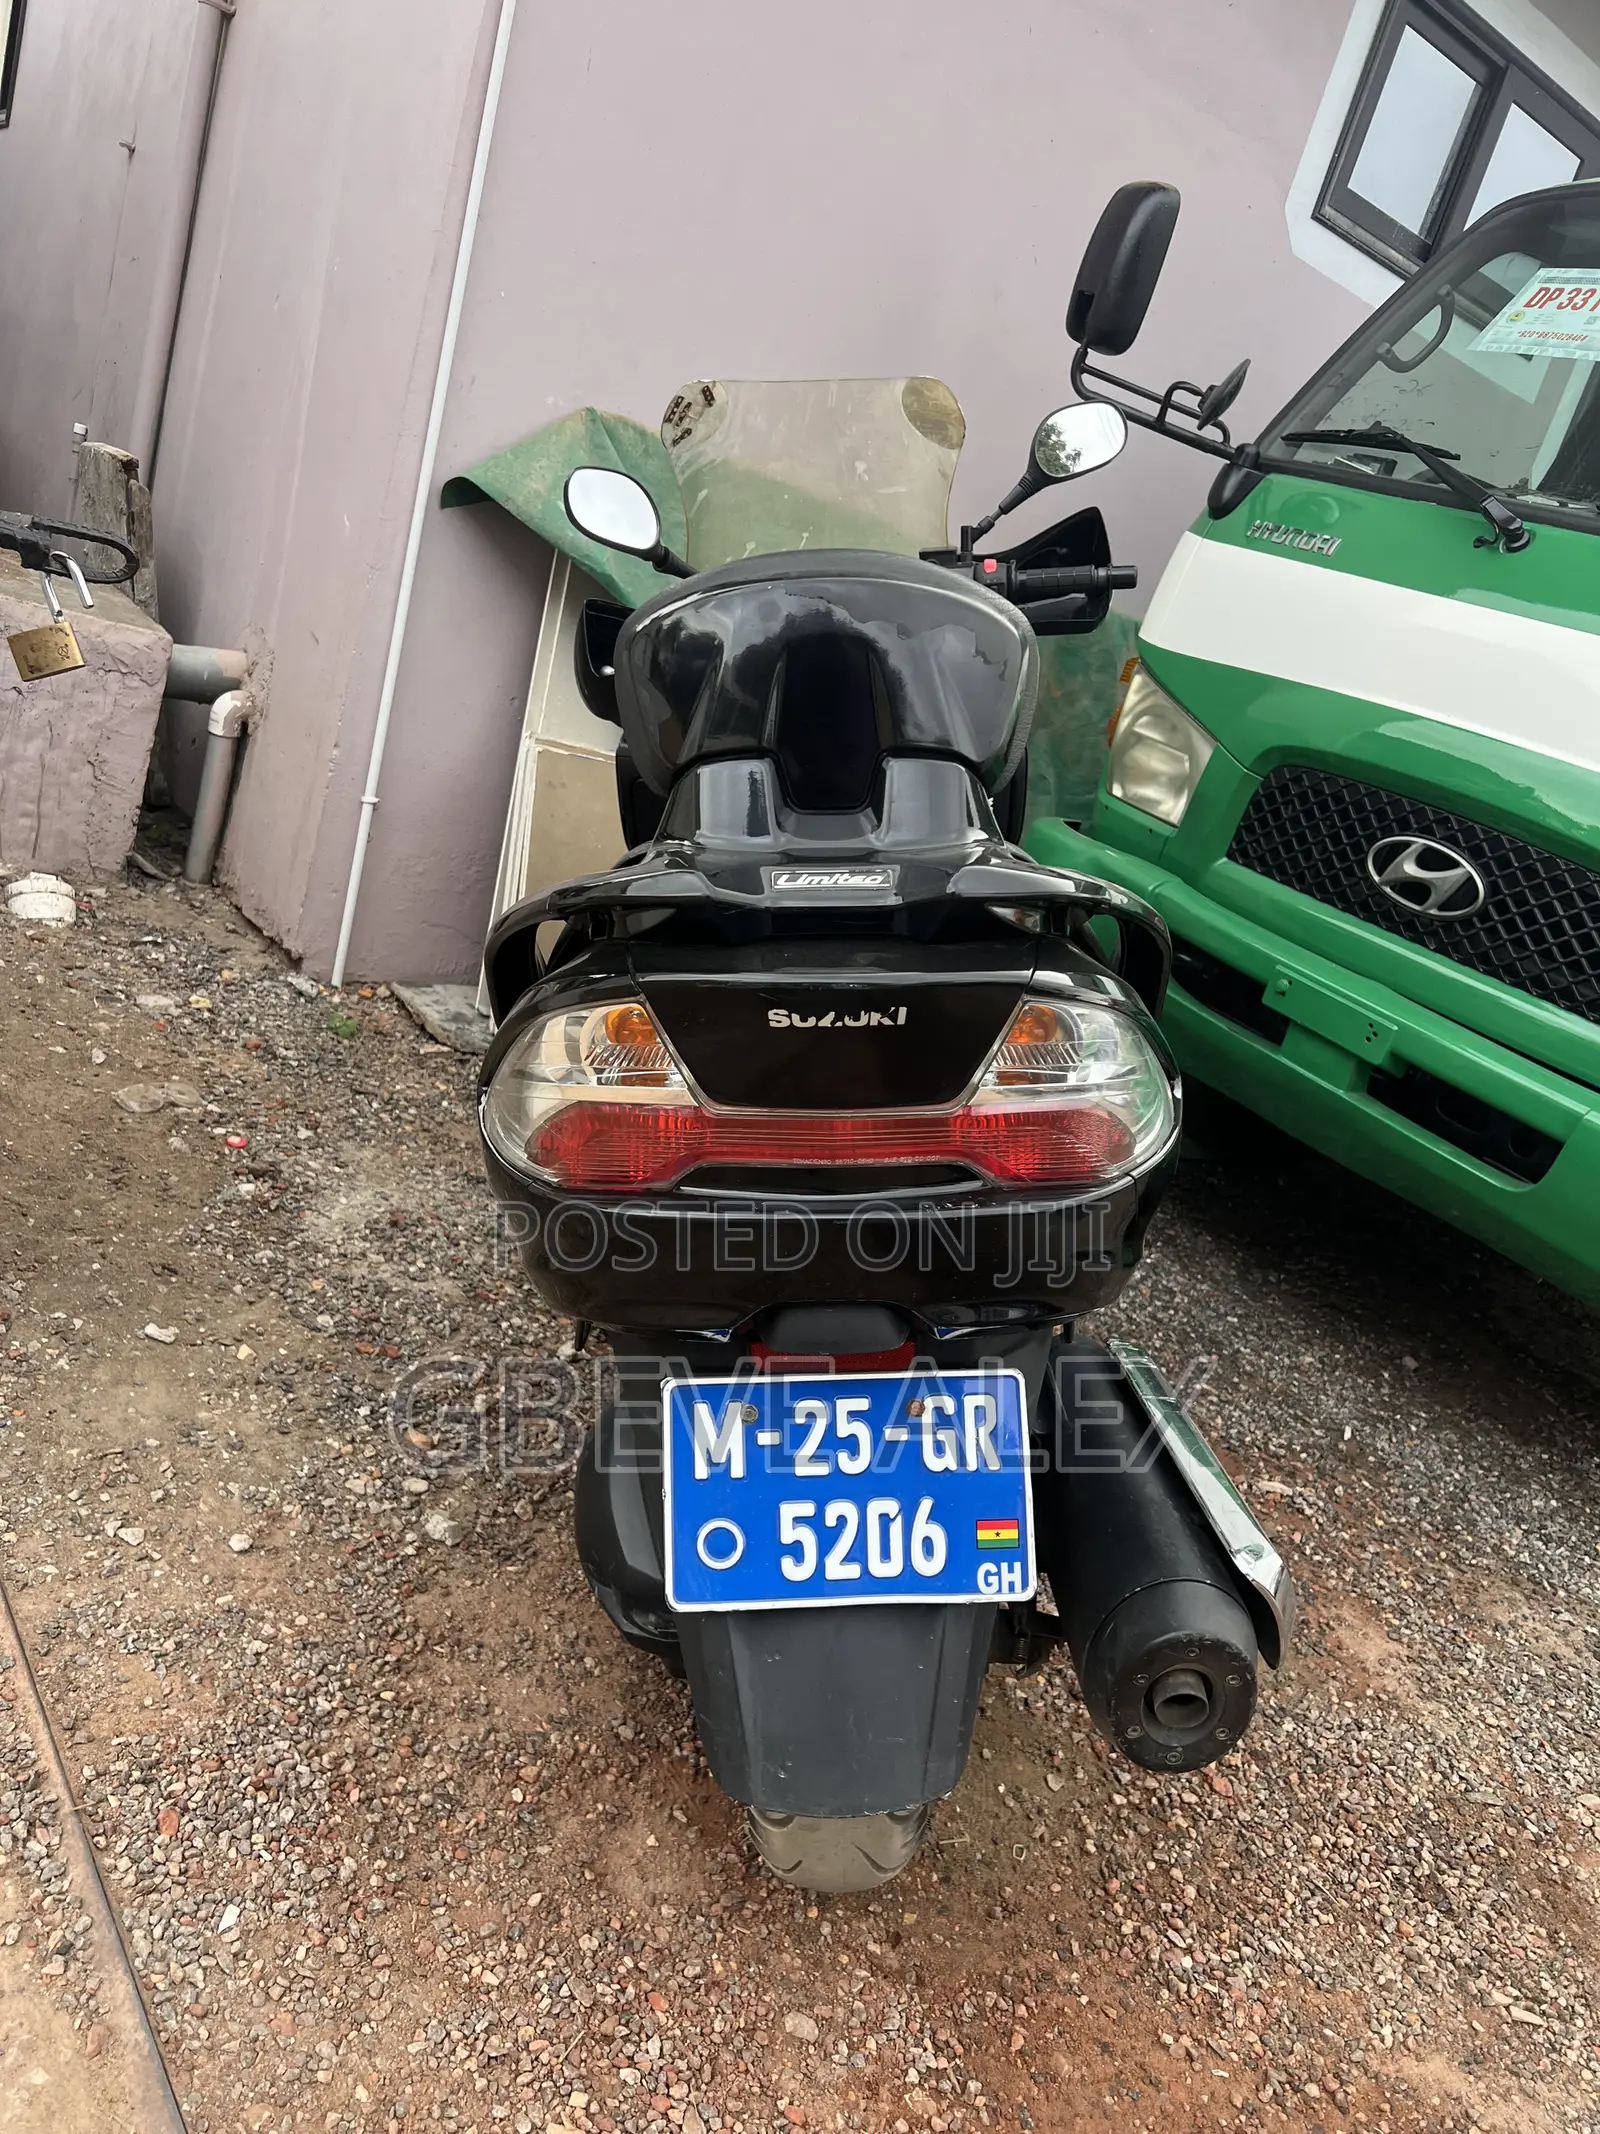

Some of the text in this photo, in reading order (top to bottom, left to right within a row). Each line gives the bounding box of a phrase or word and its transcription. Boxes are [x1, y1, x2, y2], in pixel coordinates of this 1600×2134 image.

[1246, 519, 1343, 557] HYUNDAI
[776, 872, 884, 886] Limited
[767, 1006, 908, 1028] SUZUKI
[778, 1496, 948, 1582] 5206
[976, 1560, 1023, 1595] GH
